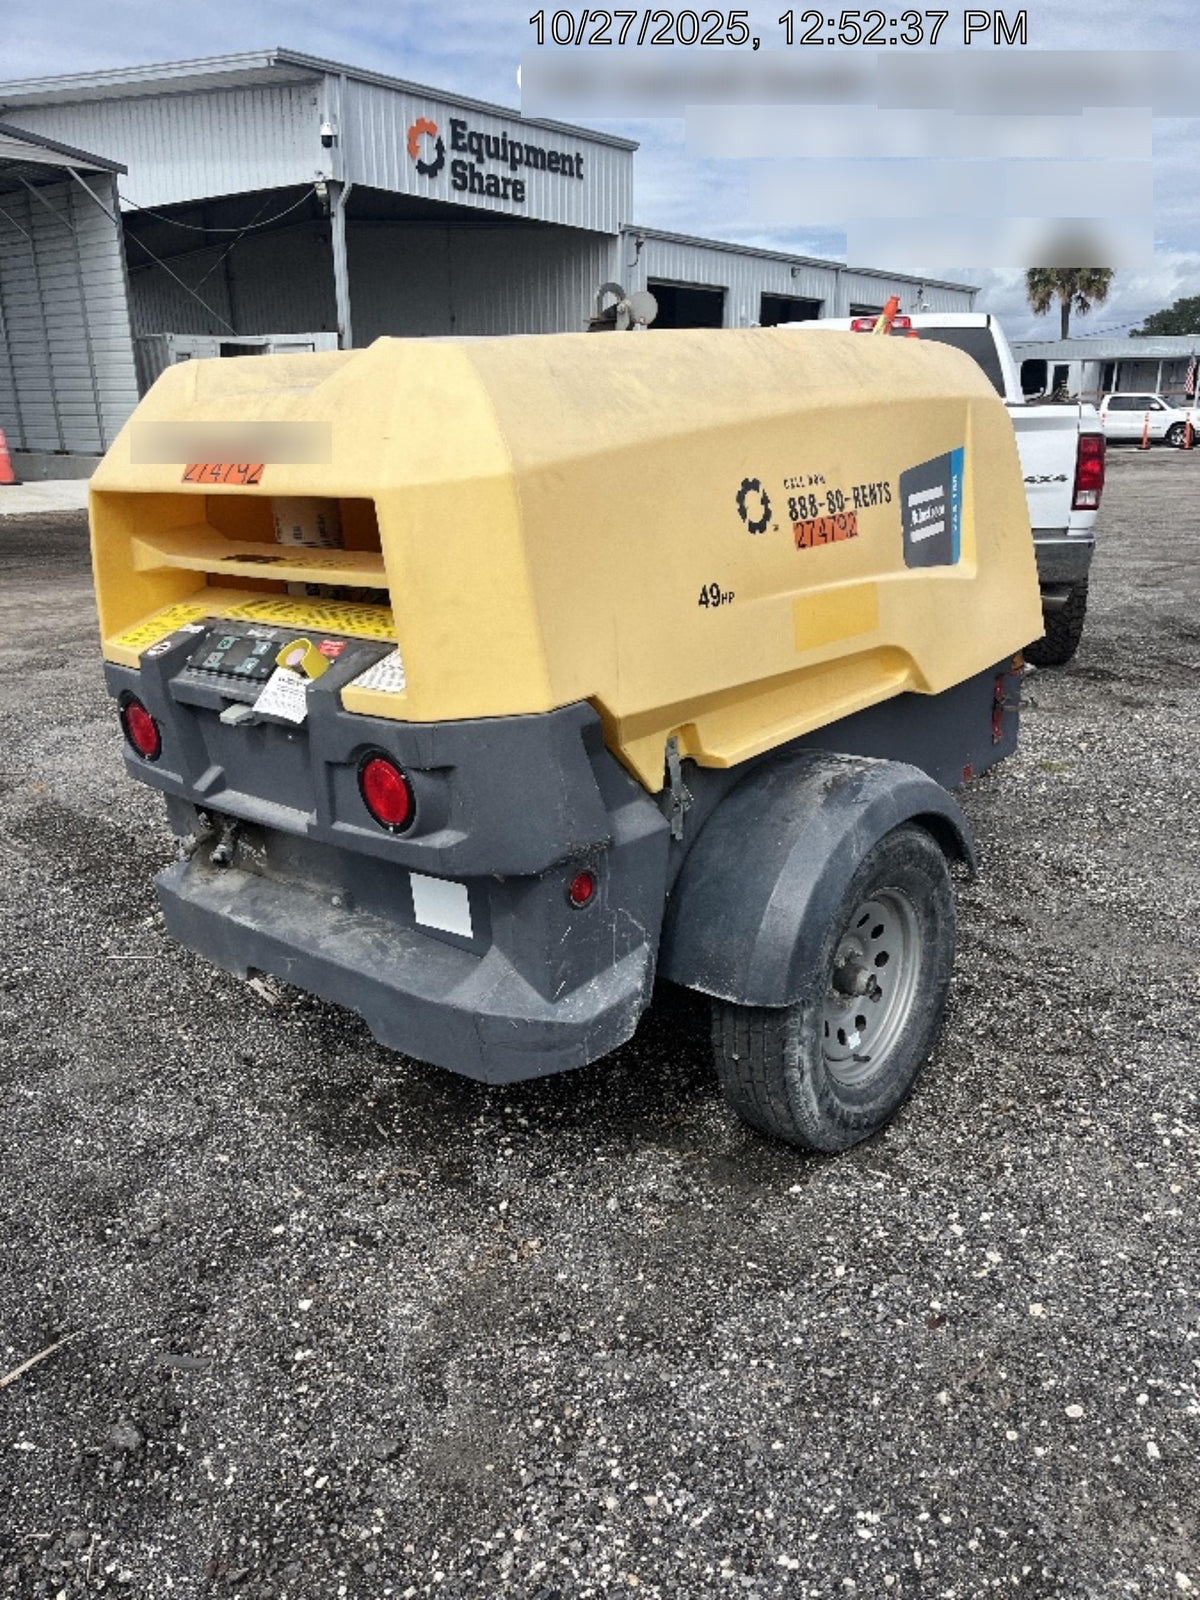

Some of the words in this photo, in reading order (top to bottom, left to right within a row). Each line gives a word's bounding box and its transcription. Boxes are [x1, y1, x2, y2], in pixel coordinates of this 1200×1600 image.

[450, 118, 584, 180] Equipment
[451, 159, 525, 203] Share
[788, 481, 892, 522] 888-80-RENTS
